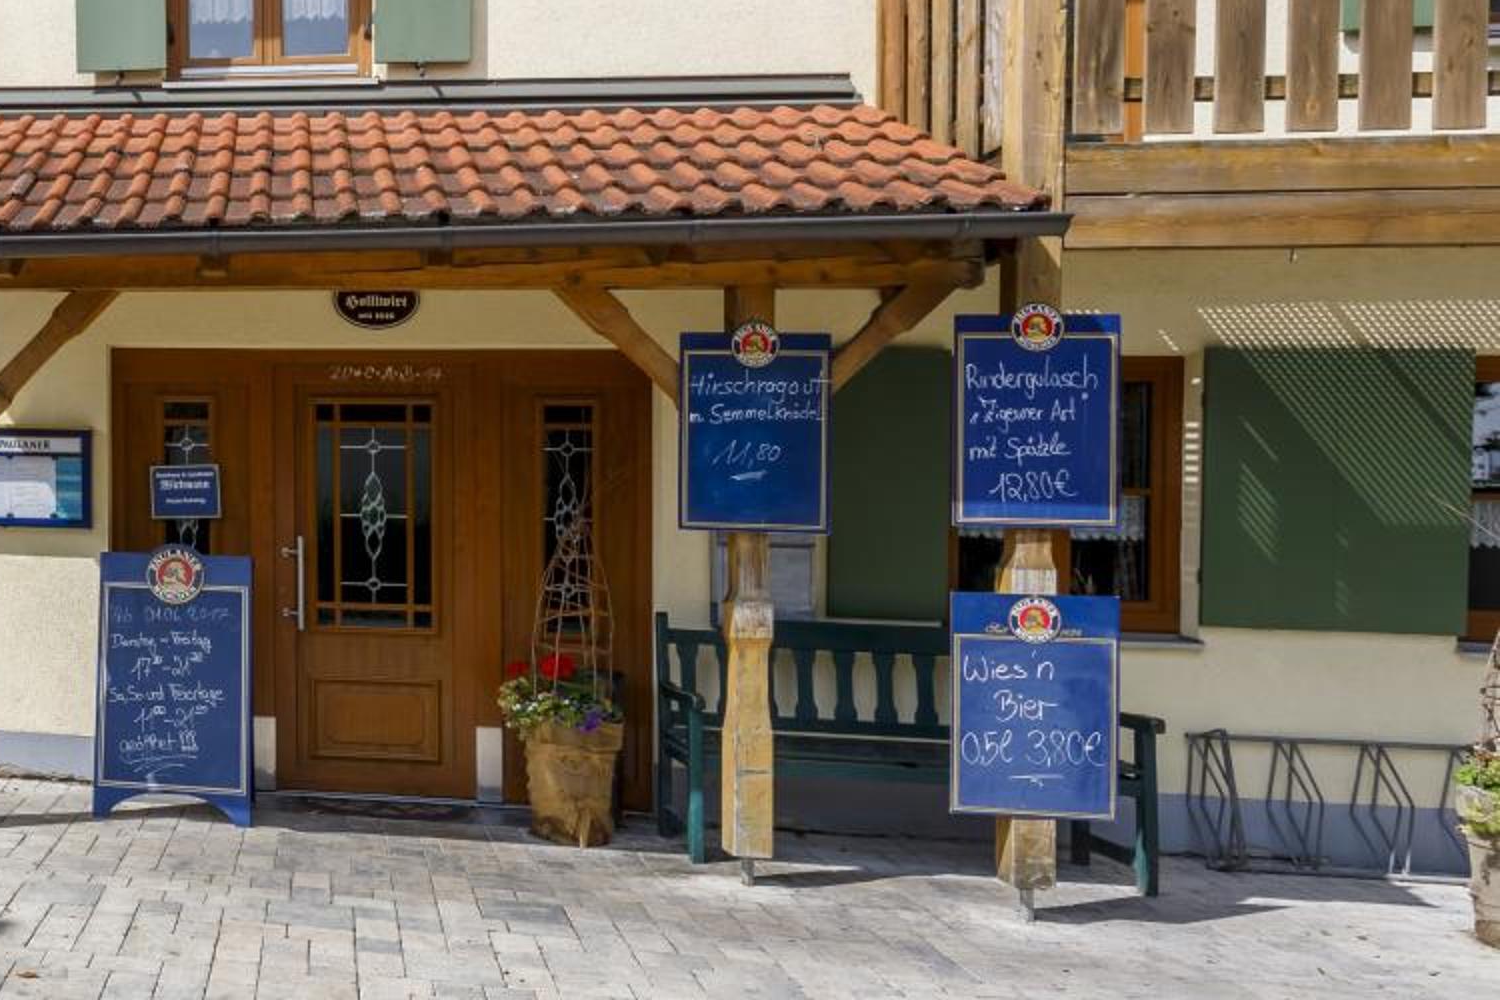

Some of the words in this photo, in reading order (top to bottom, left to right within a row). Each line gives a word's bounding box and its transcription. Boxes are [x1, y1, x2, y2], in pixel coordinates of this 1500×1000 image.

[988, 469, 1079, 503] 12,80€
[993, 689, 1060, 722] Bier
[1025, 729, 1109, 769] 3,80€
